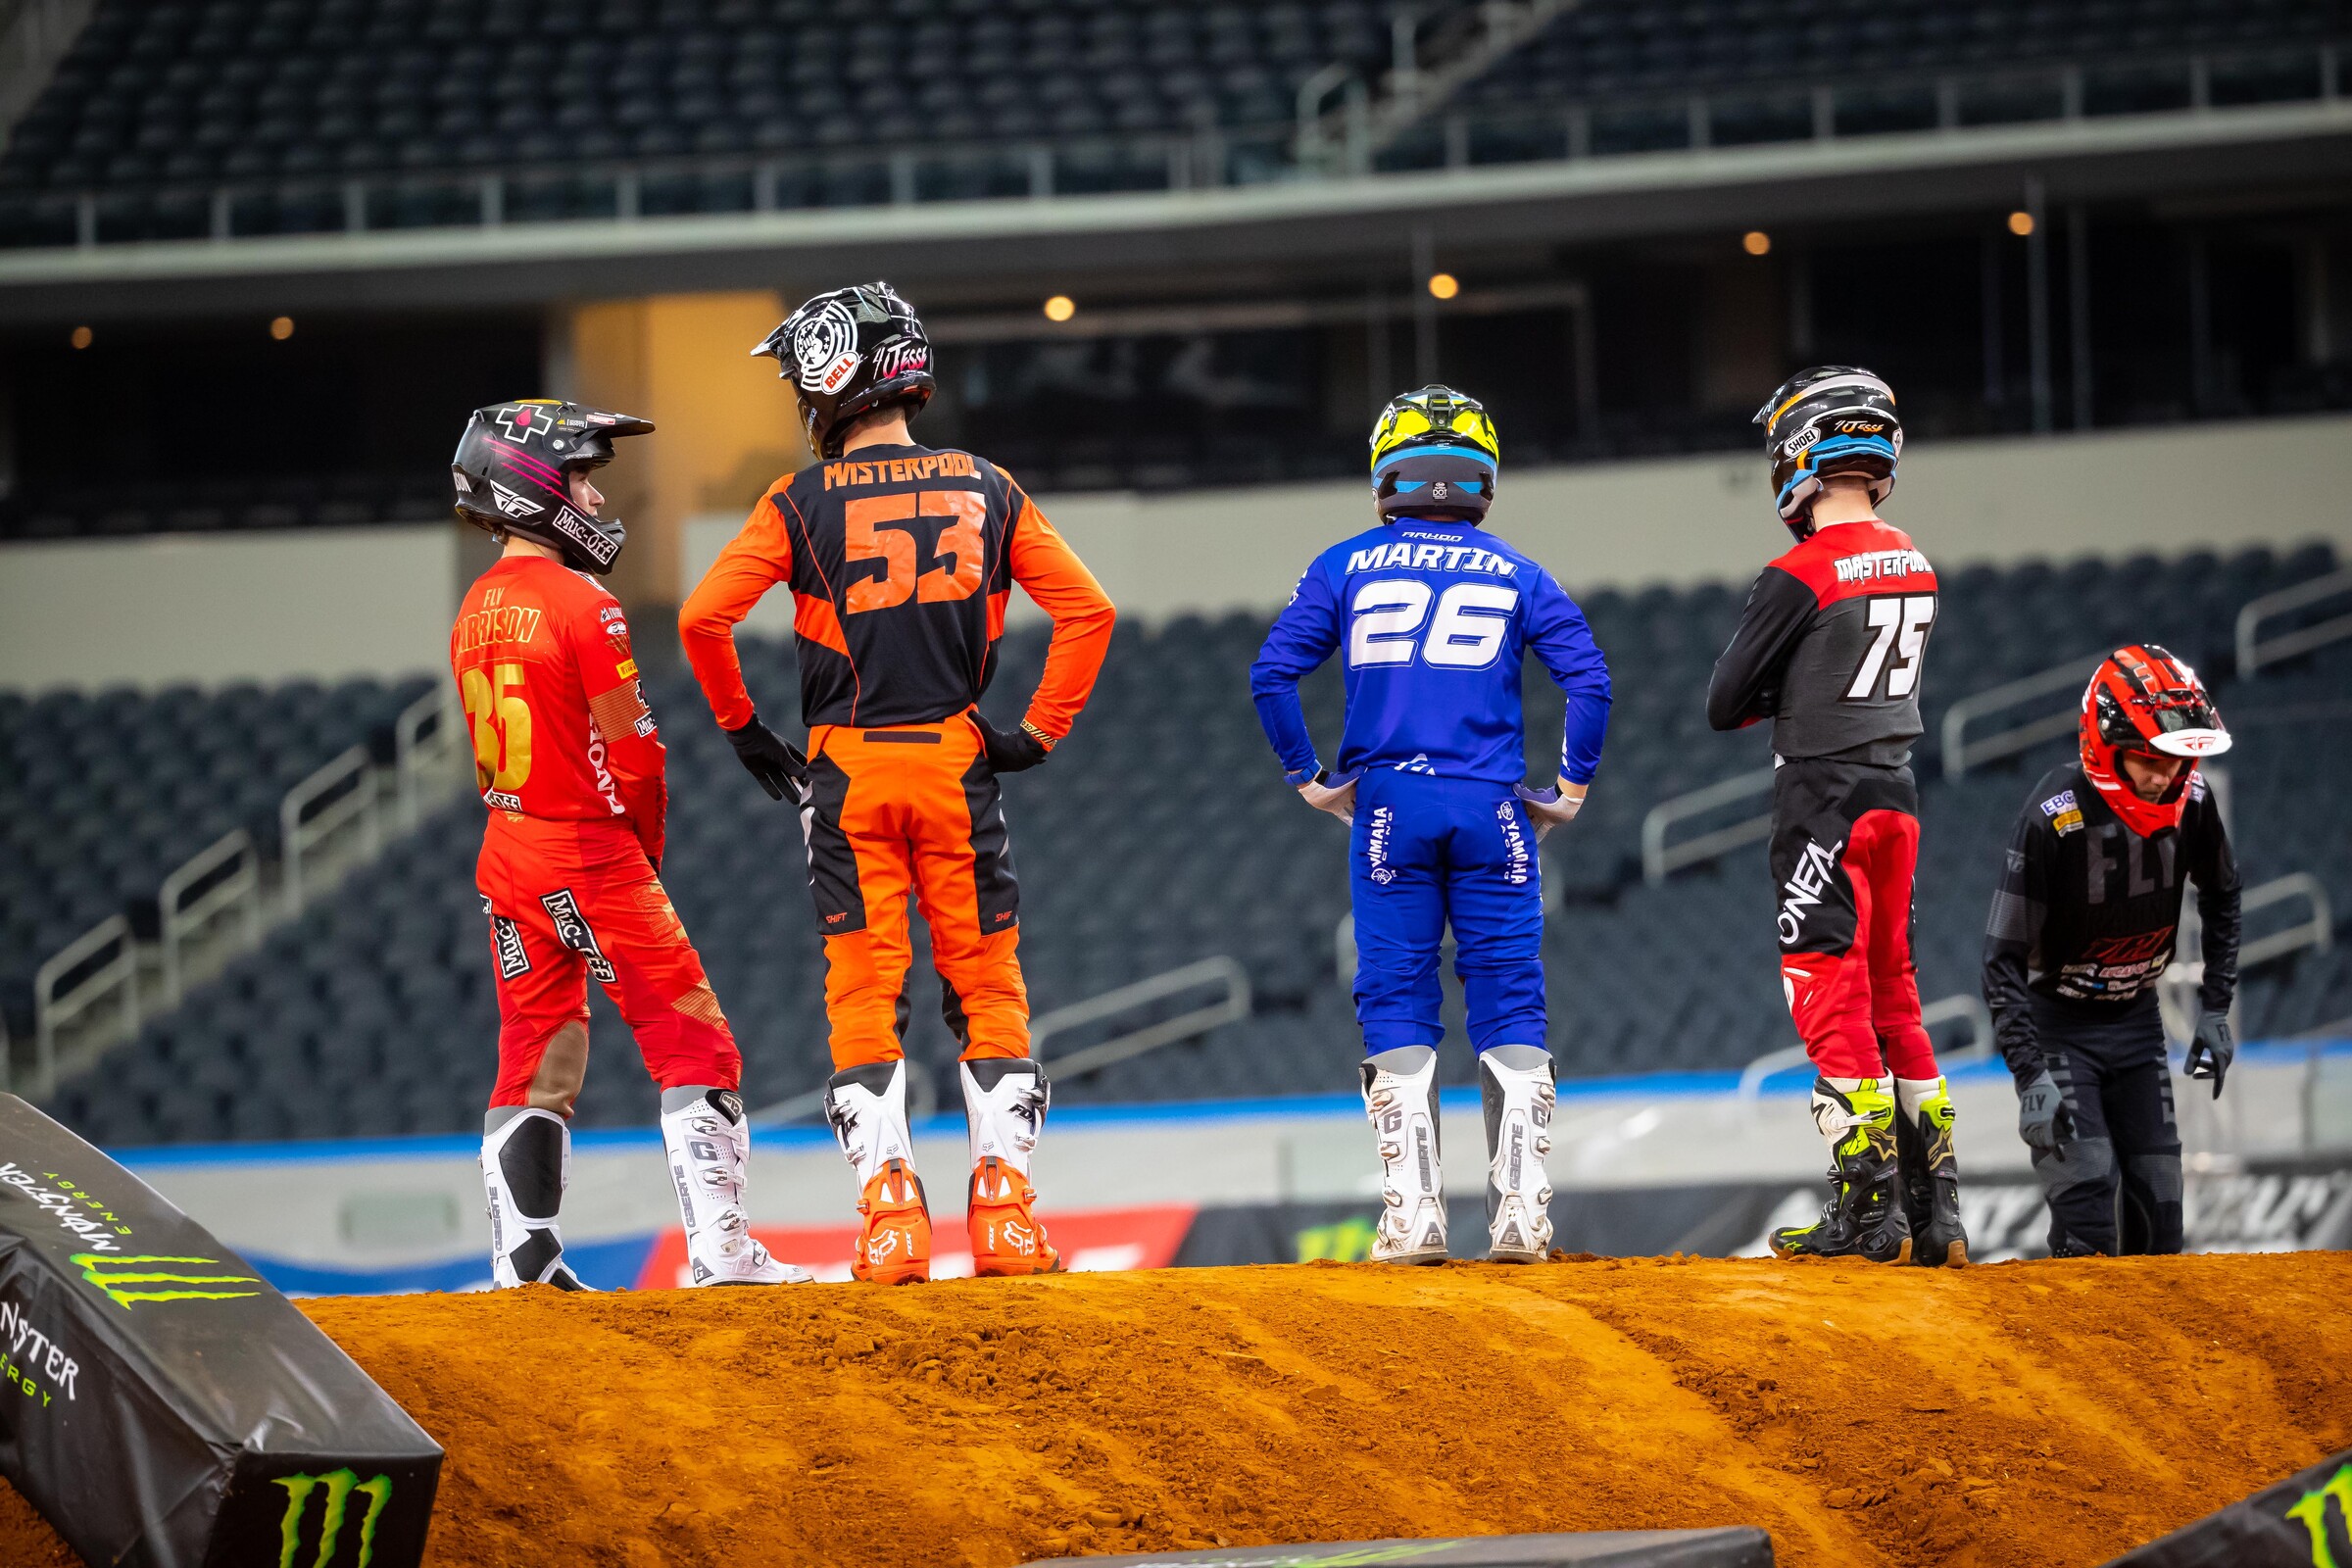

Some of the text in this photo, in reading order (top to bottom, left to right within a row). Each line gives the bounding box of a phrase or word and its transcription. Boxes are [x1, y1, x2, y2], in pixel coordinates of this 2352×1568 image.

[824, 359, 856, 389] BELL
[1788, 429, 1817, 455] SHOEI
[845, 490, 987, 615] 53
[1346, 542, 1519, 579] MARTIN
[483, 587, 506, 609] FLY
[1348, 578, 1521, 671] 26
[1840, 595, 1936, 701] 75
[461, 663, 532, 792] 35
[2043, 792, 2075, 814] EBC
[2084, 823, 2177, 905] FLY
[825, 912, 848, 924] SHIFT
[2022, 1094, 2046, 1113] FLY
[43, 1172, 132, 1235] ENERGY
